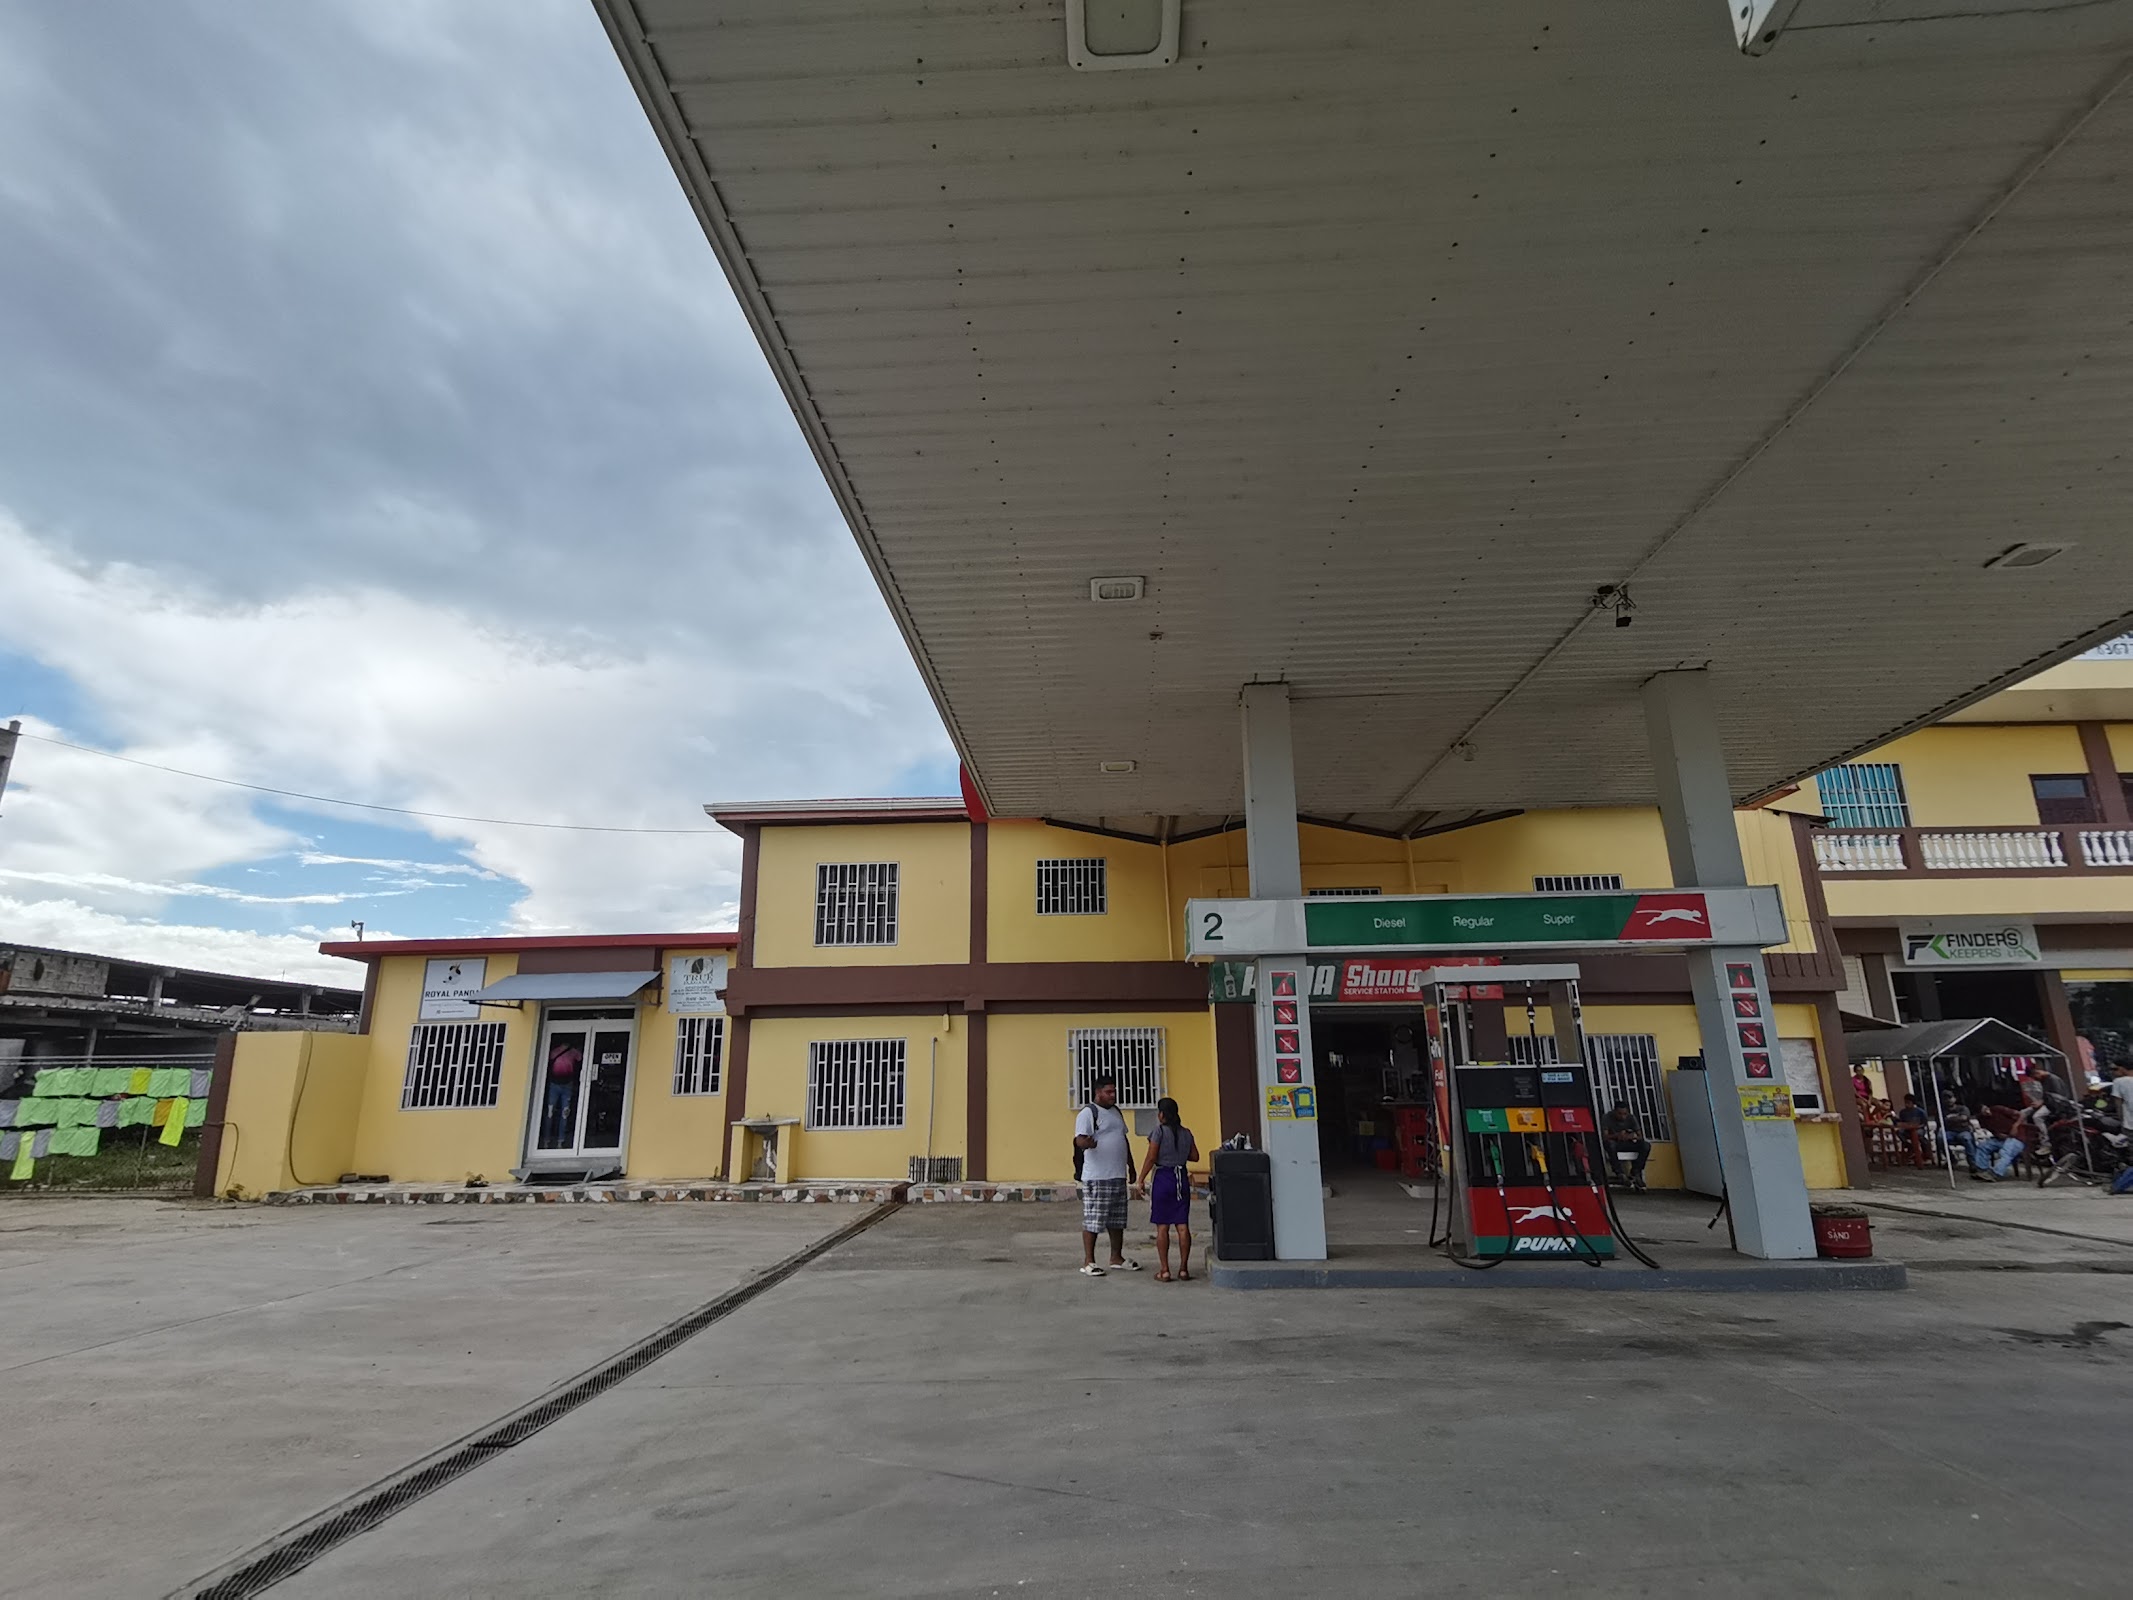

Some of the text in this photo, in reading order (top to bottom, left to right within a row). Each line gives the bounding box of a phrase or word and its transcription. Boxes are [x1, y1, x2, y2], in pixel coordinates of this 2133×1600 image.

[1373, 917, 1406, 929] Diesel
[1452, 915, 1495, 930] Regular
[1542, 913, 1576, 926] Super
[1203, 912, 1224, 941] 2
[1945, 932, 2019, 948] FINDERS
[1949, 947, 2002, 959] KEEPERS
[424, 989, 479, 998] ROYAL PAND
[1344, 987, 1405, 995] SERVICE STATION
[1827, 1230, 1850, 1240] SAND
[1514, 1236, 1577, 1252] PUMA
